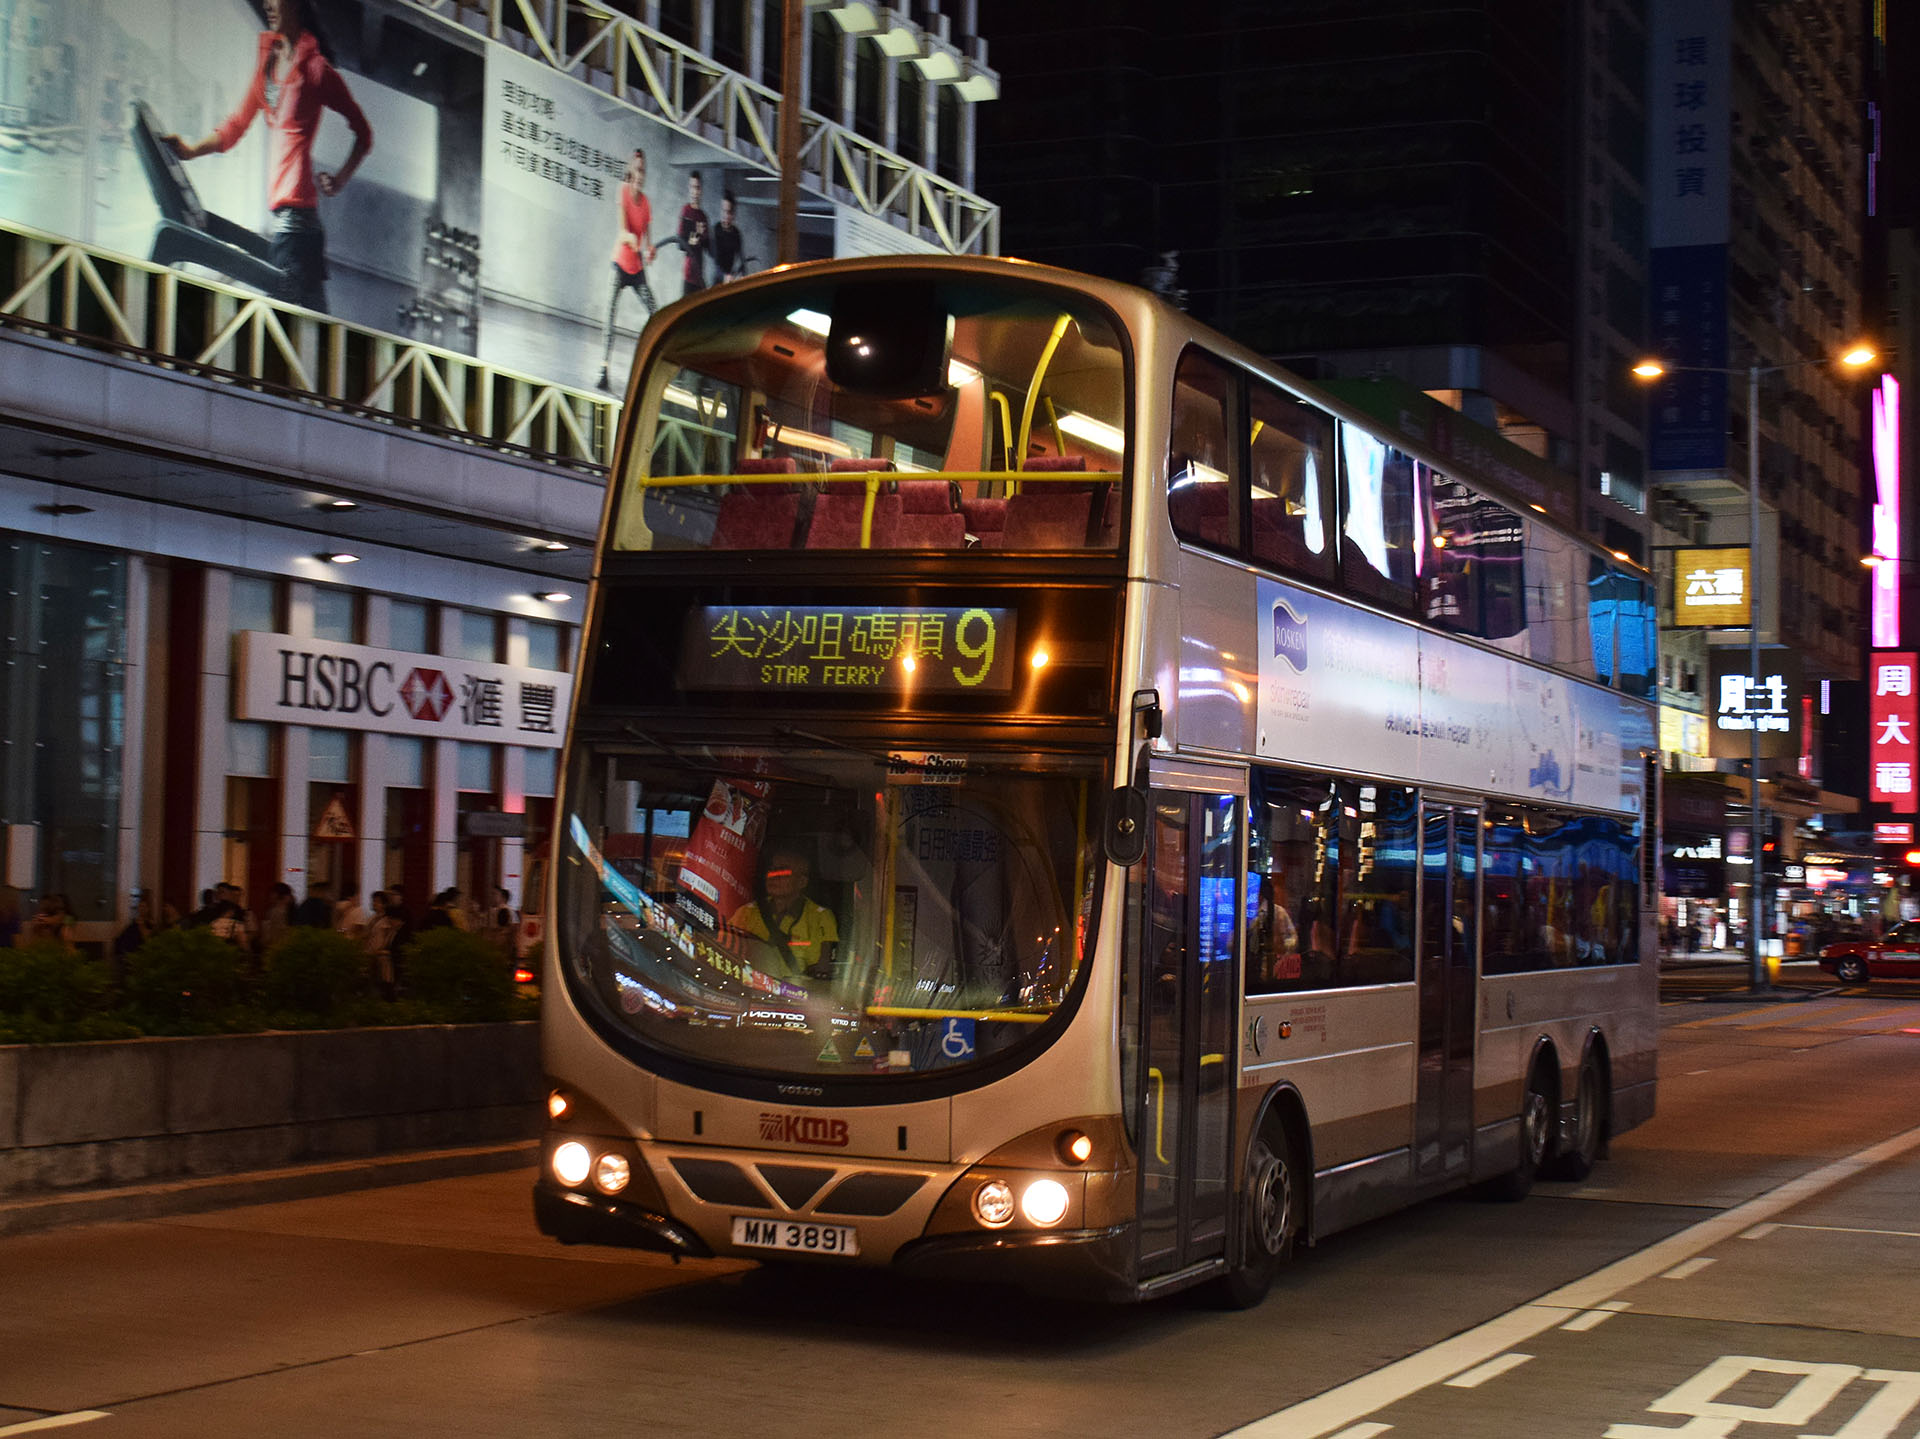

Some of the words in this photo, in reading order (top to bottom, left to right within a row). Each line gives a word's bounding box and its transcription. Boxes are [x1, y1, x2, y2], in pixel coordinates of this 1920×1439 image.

[1674, 35, 1707, 198] 環球投資
[1686, 569, 1743, 594] 六福
[711, 609, 948, 662] 尖沙咀碼頭
[952, 608, 997, 687] 9
[1276, 626, 1305, 650] ROSKEN
[278, 649, 395, 718] HSBC
[760, 664, 811, 685] STAR
[822, 665, 886, 686] FERRY
[1875, 664, 1912, 793] 周大福
[888, 752, 968, 775] RoadShow
[778, 1084, 823, 1097] VOLVO
[785, 1114, 849, 1147] KMB
[744, 1221, 777, 1245] MM
[786, 1224, 846, 1252] 3891
